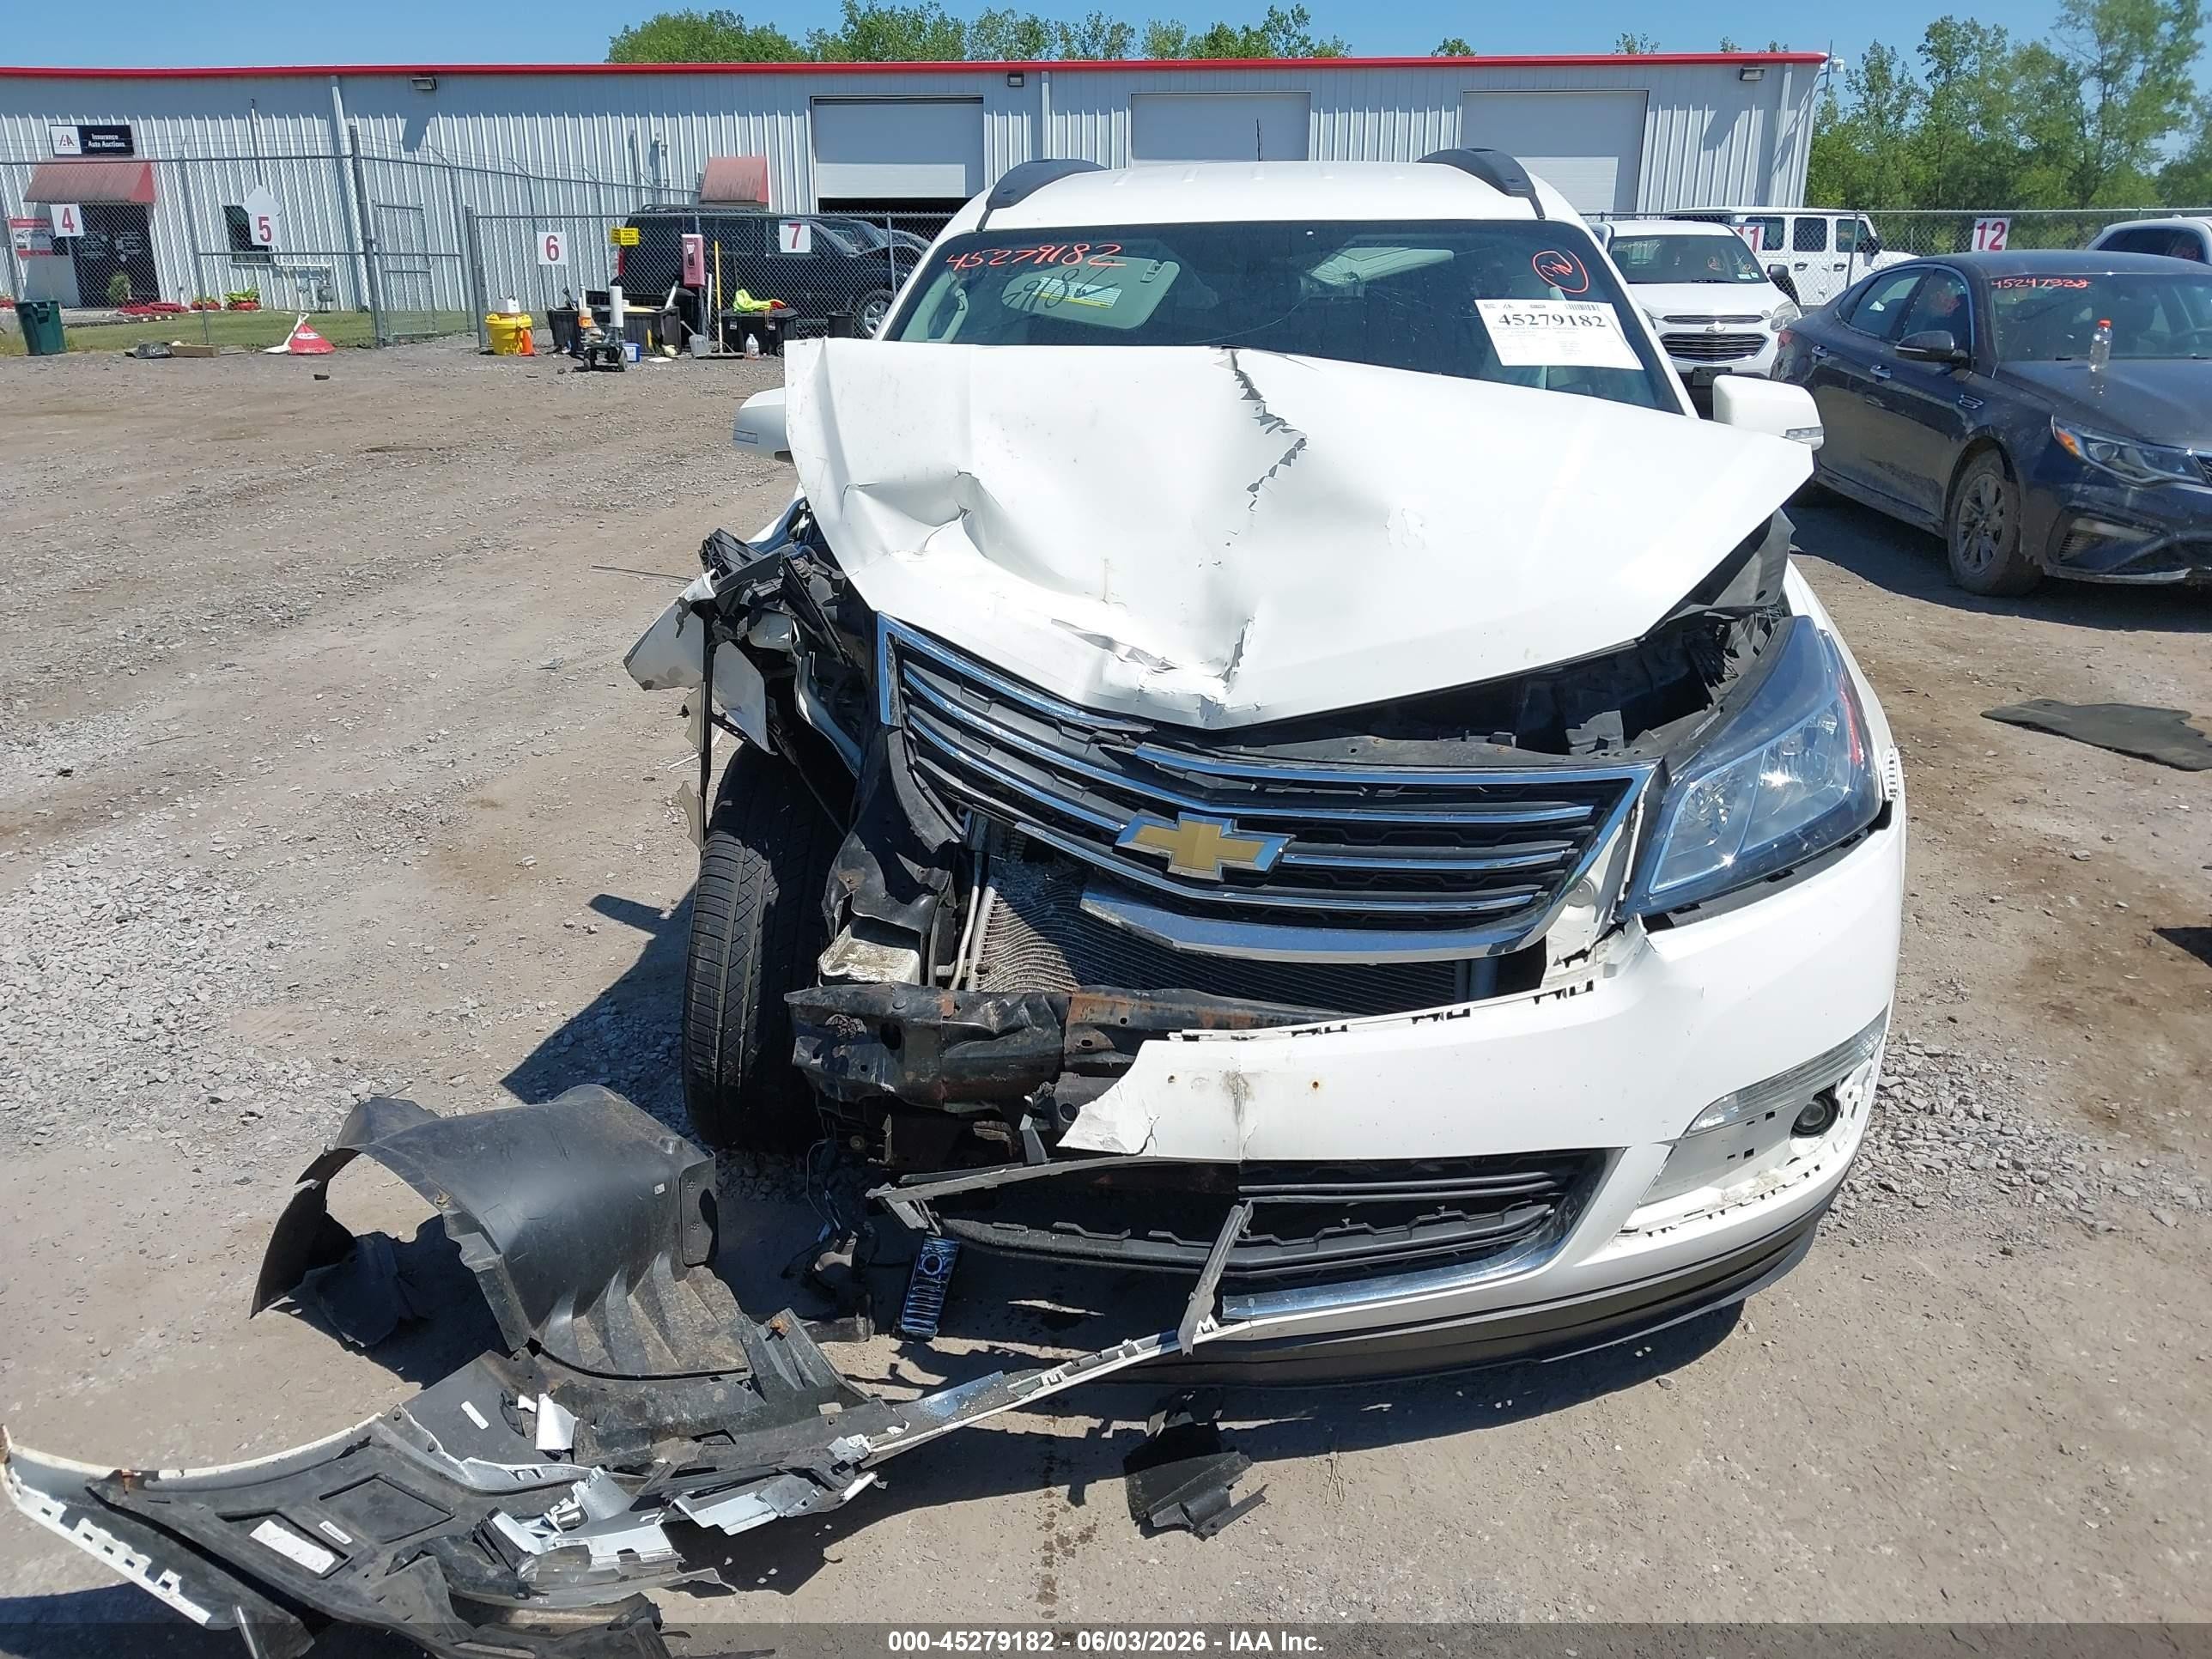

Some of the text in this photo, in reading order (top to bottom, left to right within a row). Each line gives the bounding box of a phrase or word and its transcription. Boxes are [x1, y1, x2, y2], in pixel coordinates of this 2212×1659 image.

[62, 208, 75, 233] 4
[258, 216, 271, 242] 5
[545, 235, 560, 261] 6
[787, 223, 801, 250] 7
[1977, 221, 2006, 251] 12
[945, 243, 1127, 271] 45279182
[1498, 313, 1607, 327] 45279182
